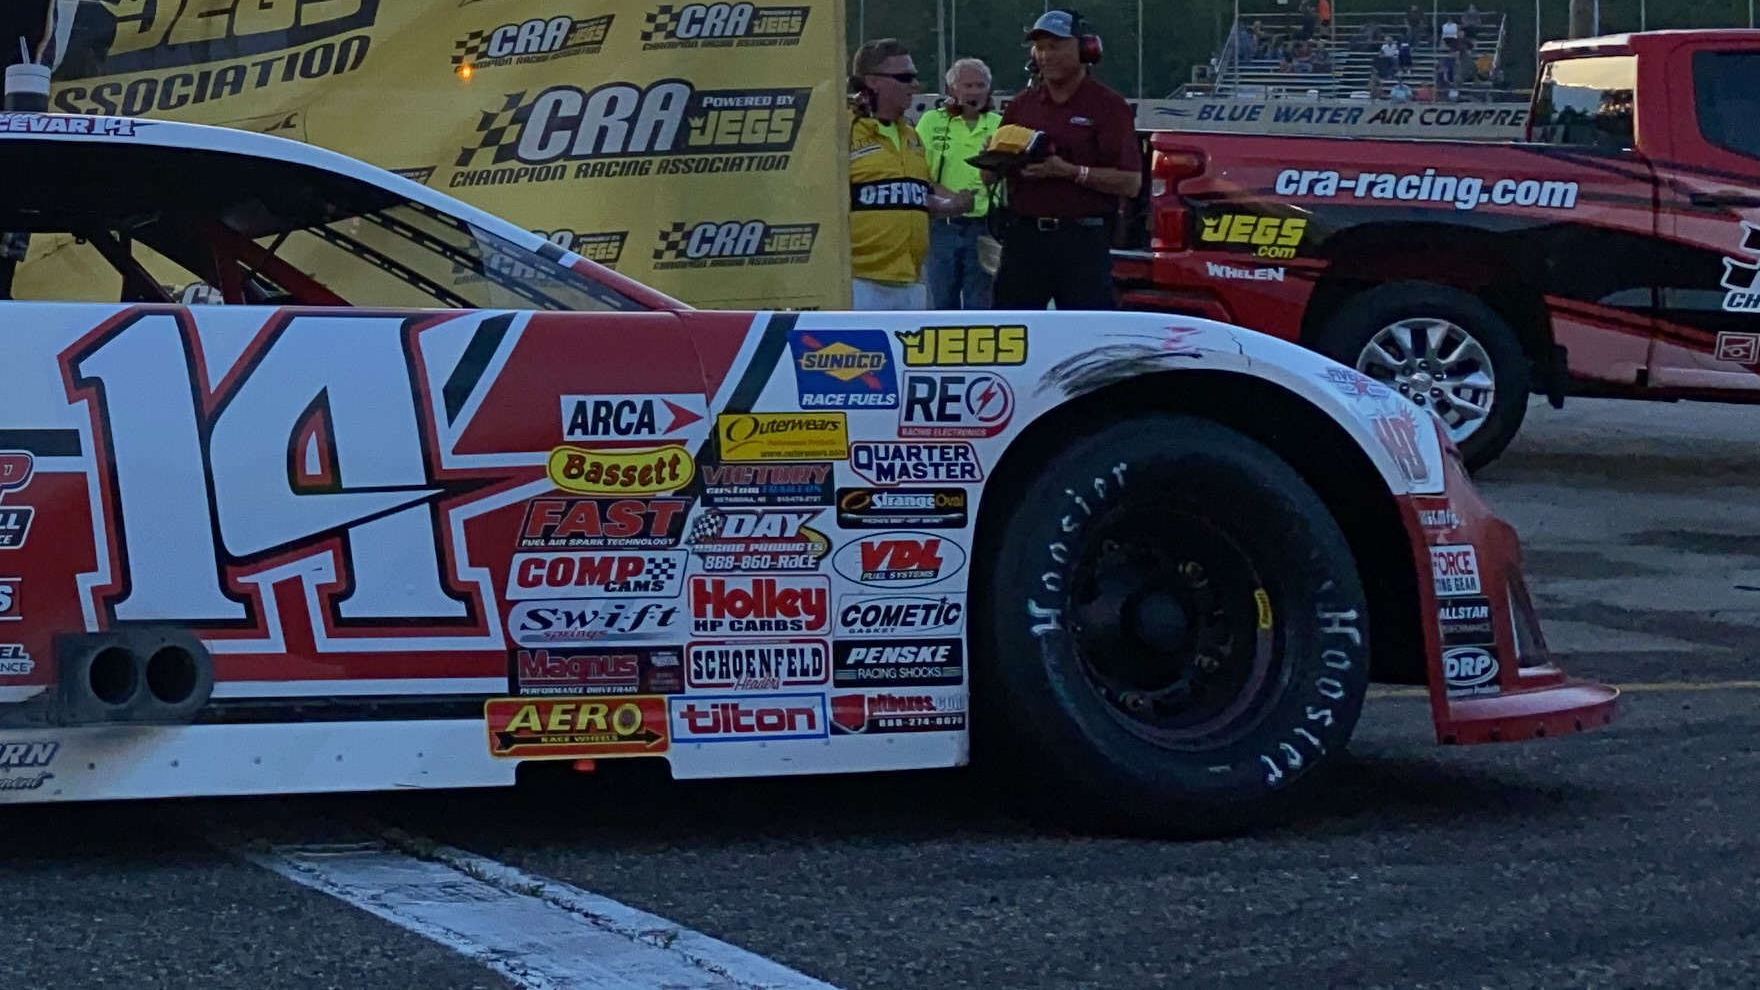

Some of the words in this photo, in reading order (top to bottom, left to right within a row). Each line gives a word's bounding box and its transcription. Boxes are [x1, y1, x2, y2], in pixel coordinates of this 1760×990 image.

[676, 2, 754, 39] CRA
[755, 16, 802, 35] JEGS
[488, 16, 572, 59] CRA
[54, 35, 371, 114] SSOCIATION
[702, 95, 772, 108] POWERED
[776, 95, 796, 107] BY
[91, 117, 135, 137] 14
[518, 82, 691, 162] CRA
[689, 108, 797, 147] JEGS
[1197, 105, 1265, 122] BLUE
[1273, 106, 1363, 124] WATER
[1368, 108, 1414, 125] AIR
[449, 164, 567, 188] CHAMPION
[574, 161, 652, 180] RACING
[656, 155, 791, 175] ASSOCIATION
[1275, 168, 1579, 210] cra-racing.com
[686, 221, 764, 259] CRA
[765, 233, 813, 252] JEGS
[1200, 214, 1307, 246] JEGS
[1253, 245, 1296, 259] .com
[1206, 261, 1285, 282] WHELEN
[901, 325, 1029, 367] JEGS
[804, 353, 883, 369] SUNOCO
[802, 393, 844, 406] RACE
[848, 393, 897, 406] FUELS
[903, 375, 966, 423] RE
[567, 399, 656, 436] ARCA
[726, 415, 842, 442] Outerwears
[68, 310, 480, 628] 14
[562, 453, 681, 487] Bassett
[853, 445, 970, 471] QUARTER
[702, 465, 831, 485] VICTORY
[876, 462, 977, 482] MASTER
[524, 500, 686, 538] FAST
[720, 513, 814, 538] DAY
[522, 538, 545, 547] FUEL
[548, 538, 567, 547] AIR
[569, 538, 604, 547] SPARK
[607, 537, 676, 547] TECHNOLOGY
[748, 542, 823, 553] PRODUCTS
[860, 539, 944, 572] VDL
[516, 556, 645, 589] COMP
[862, 571, 887, 580] FUEL
[889, 570, 934, 579] SYSTEMS
[1454, 577, 1477, 592] GEAR
[603, 580, 665, 593] CAMS
[692, 578, 827, 631] Holley
[841, 601, 962, 628] COMETIC
[1439, 606, 1490, 621] ALLSTAR
[694, 620, 724, 632] HP
[729, 619, 804, 632] CARBS
[517, 650, 640, 682] Magnus
[692, 648, 823, 680] SCHOENFELD
[846, 646, 951, 665] PENSKE
[1444, 654, 1491, 679] DRP
[734, 672, 780, 691] Headers
[857, 668, 897, 679] RACING
[899, 666, 940, 678] SHOCKS
[520, 686, 585, 695] PERFORMANCE
[587, 685, 639, 694] DRIVETRAIN
[1260, 607, 1362, 785] Hoosier
[504, 703, 642, 735] AERO
[680, 703, 817, 734] tilton
[541, 735, 571, 744] RACE
[573, 734, 619, 743] WHEELS
